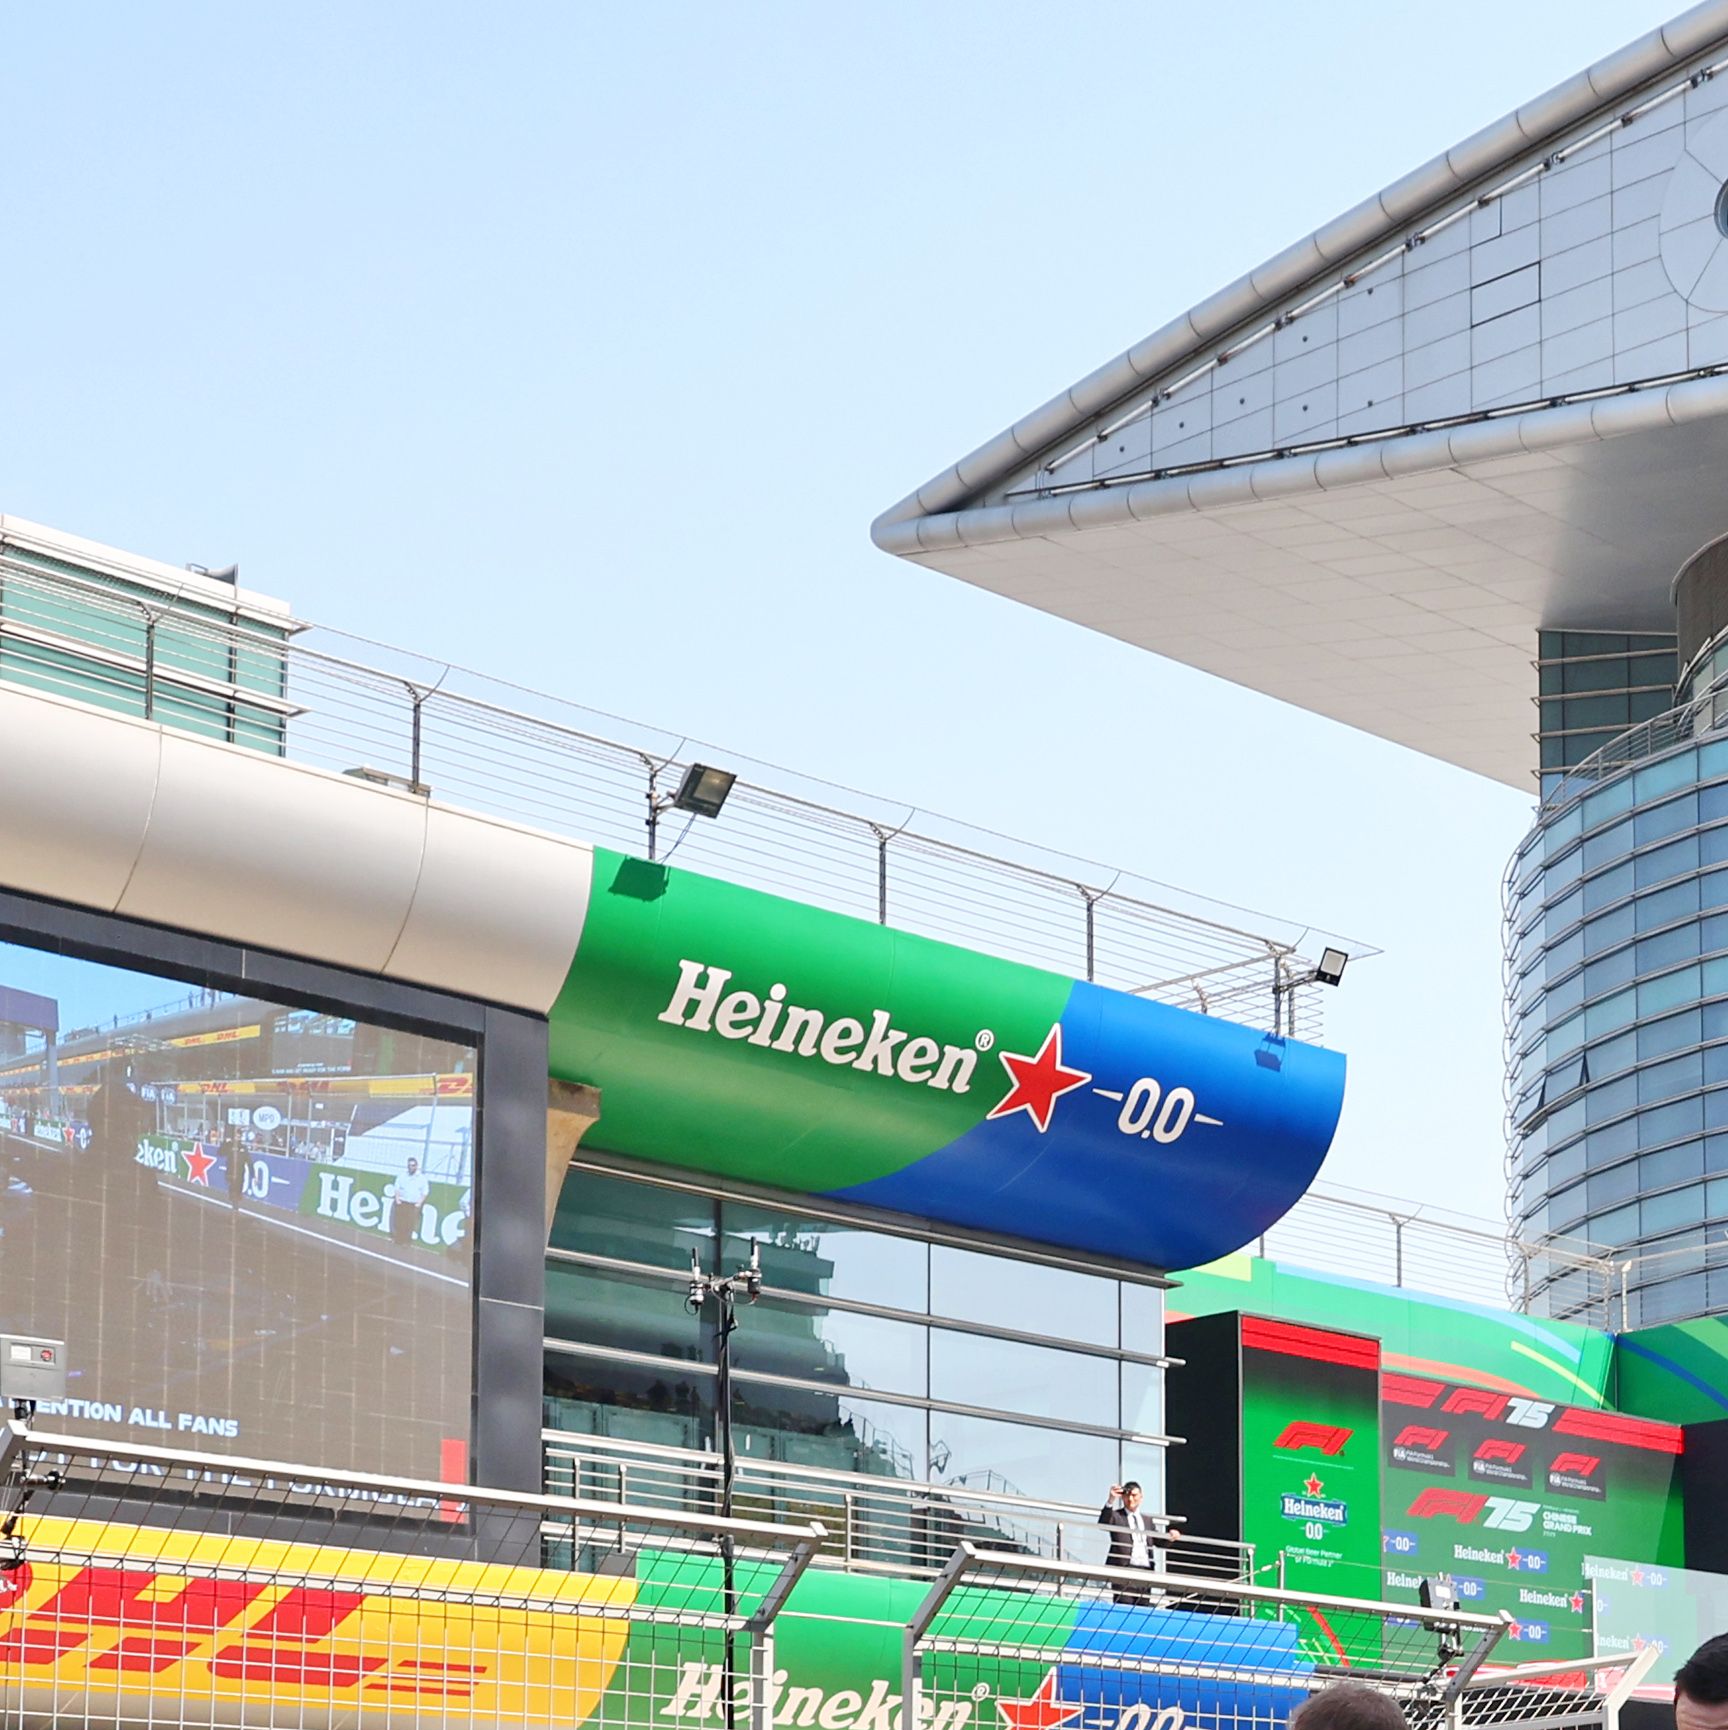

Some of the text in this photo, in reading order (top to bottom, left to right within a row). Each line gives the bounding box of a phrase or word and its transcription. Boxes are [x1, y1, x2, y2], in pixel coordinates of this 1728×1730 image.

[658, 960, 976, 1094] Heineken
[128, 1407, 172, 1430] ALL
[177, 1412, 239, 1437] FANS
[1284, 1497, 1343, 1521] Heineken
[1454, 1544, 1504, 1563] Heineken
[1519, 1589, 1568, 1607] Heineken
